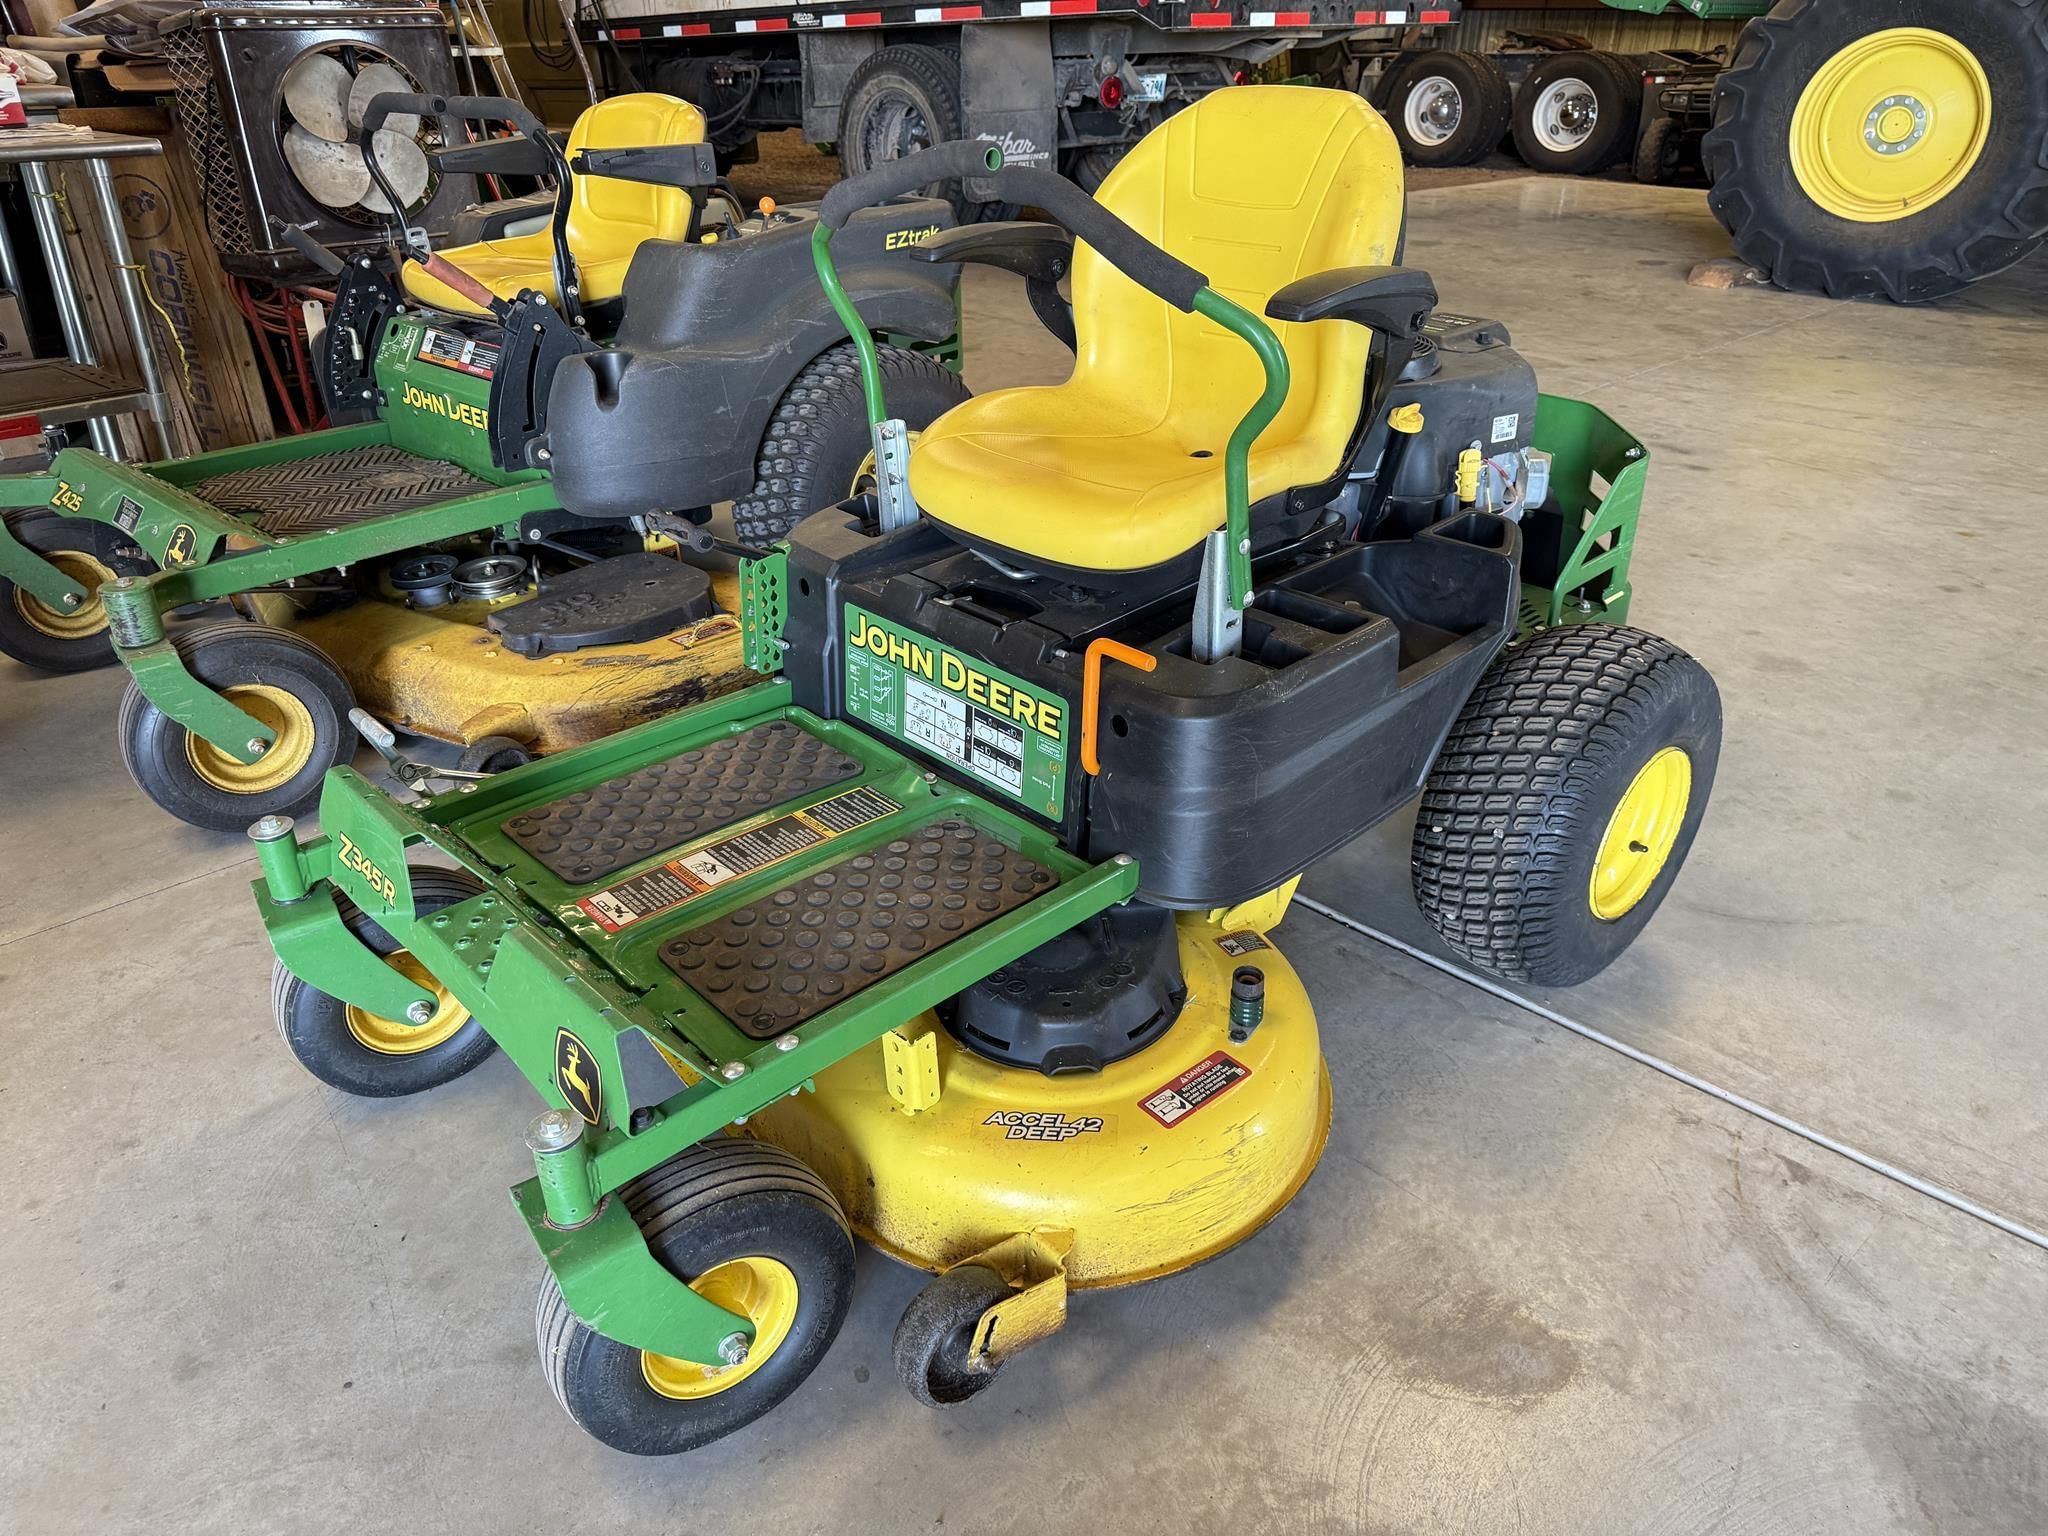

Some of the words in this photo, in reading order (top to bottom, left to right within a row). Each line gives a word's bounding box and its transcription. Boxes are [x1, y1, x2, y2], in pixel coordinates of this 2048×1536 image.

[148, 248, 222, 442] CORNWELL
[402, 381, 446, 418] JOHN
[51, 480, 84, 512] Z425
[849, 612, 933, 681] JOHN
[940, 648, 1063, 742] DEERE
[945, 751, 975, 772] OPERATION
[337, 831, 398, 909] Z345R
[1182, 1075, 1207, 1092] ROTATING
[1205, 1064, 1223, 1076] BLADE
[1185, 1060, 1213, 1078] DANGER
[983, 1111, 1069, 1128] ACCEL
[1005, 1125, 1079, 1142] DEEP
[1064, 1116, 1104, 1133] 42
